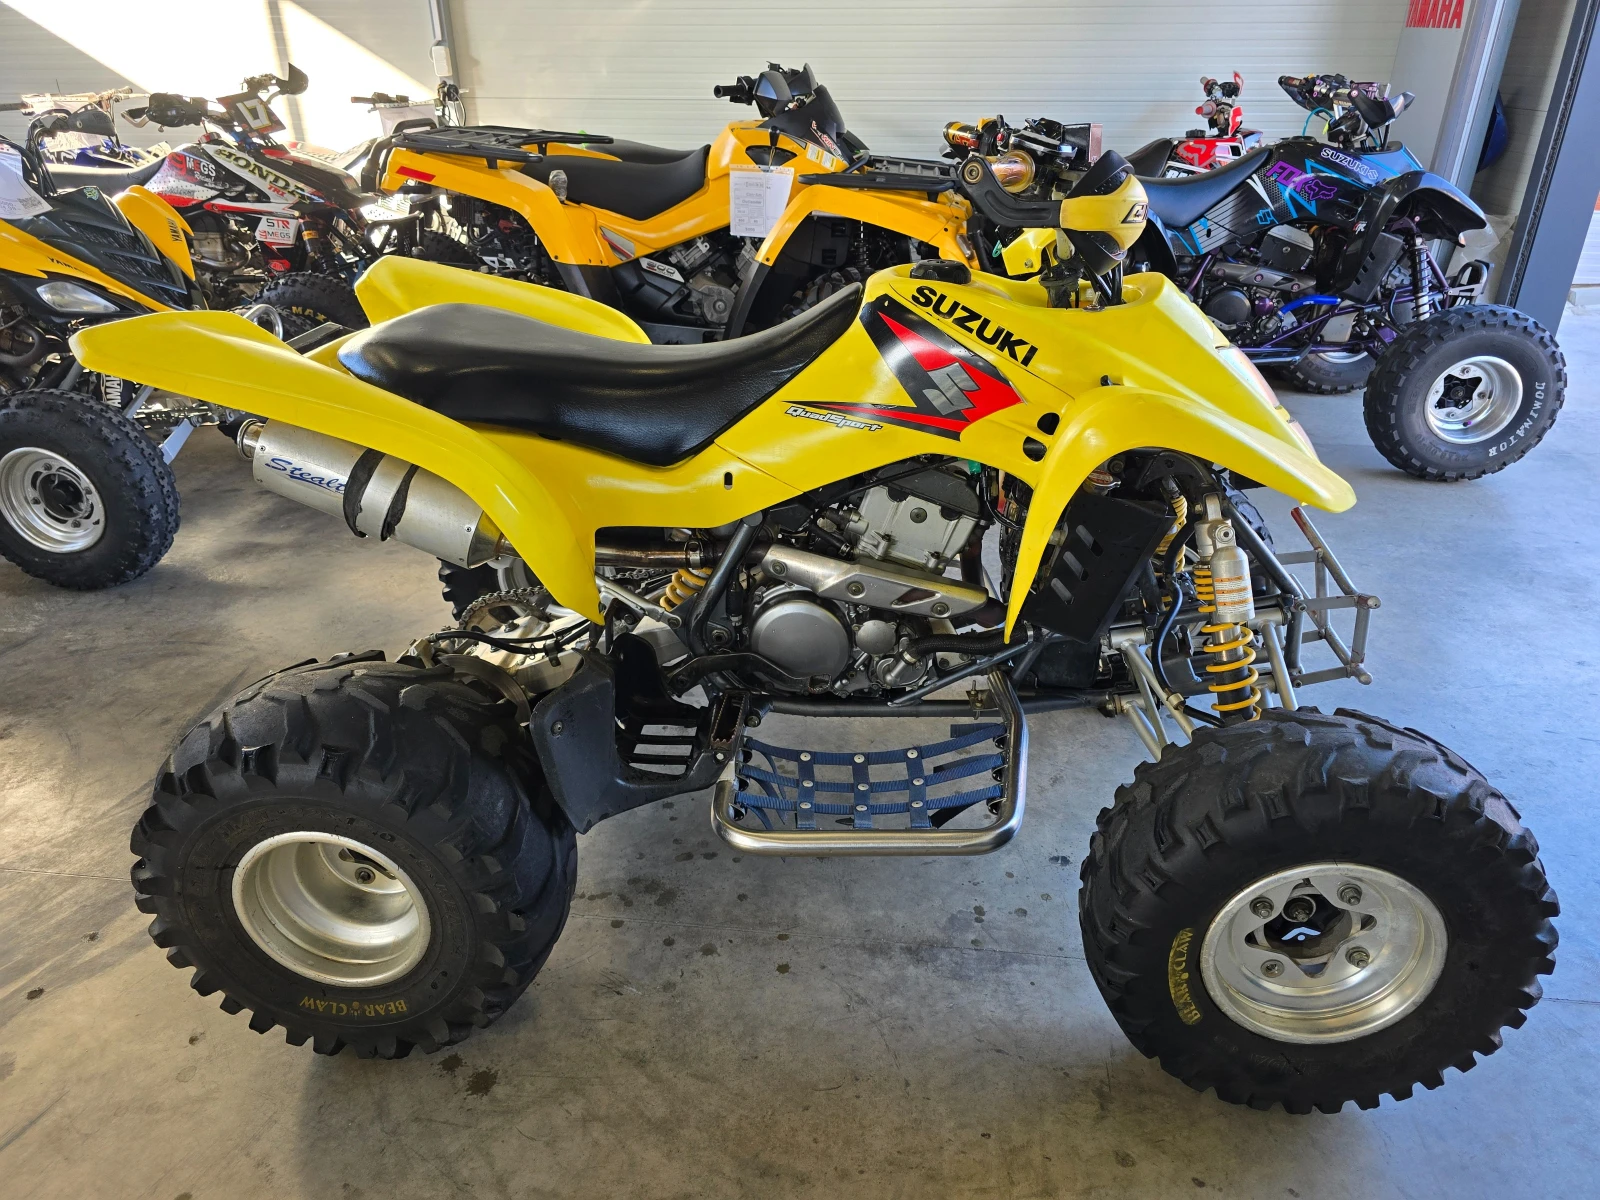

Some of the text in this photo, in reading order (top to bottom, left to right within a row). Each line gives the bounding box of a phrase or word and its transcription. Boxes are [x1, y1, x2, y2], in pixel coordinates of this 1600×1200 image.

[214, 148, 310, 204] HONDA
[1265, 160, 1317, 193] FOX
[1321, 148, 1370, 176] SUZUKI
[267, 231, 291, 239] MEGS
[291, 306, 331, 323] MAX
[911, 285, 1039, 367] SUZUKI
[785, 405, 883, 431] QuadSport
[1488, 381, 1546, 457] DOMINATOR
[264, 457, 347, 493] Stealt
[1173, 930, 1201, 1023] BEAR CLAW
[299, 996, 408, 1017] BEAR CLAW
